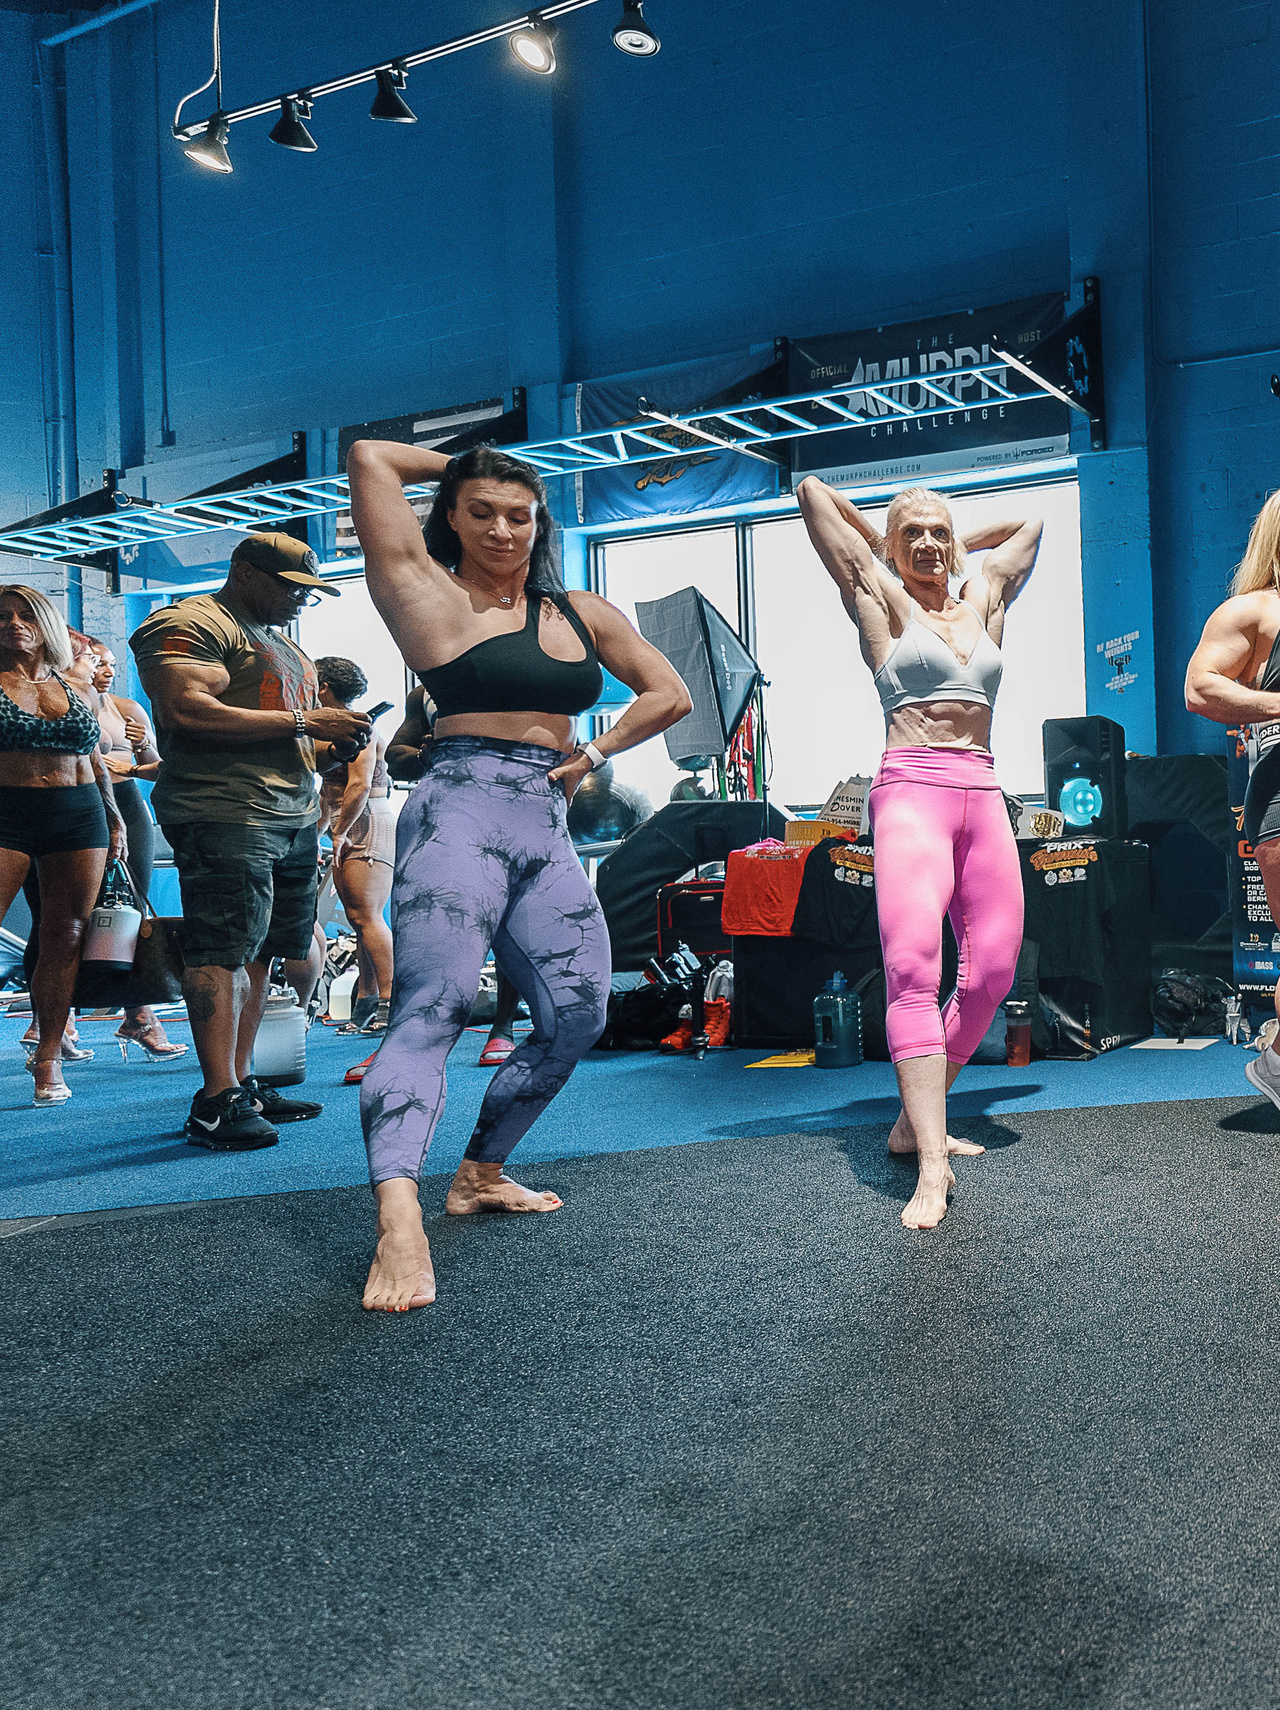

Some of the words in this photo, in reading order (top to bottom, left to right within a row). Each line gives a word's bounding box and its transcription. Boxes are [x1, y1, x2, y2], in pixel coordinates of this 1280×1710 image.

[916, 333, 954, 351] THE
[1017, 330, 1041, 344] HOST
[810, 364, 848, 381] OFFICIAL
[864, 343, 1008, 417] MURPH
[870, 406, 1006, 438] CHALLENGE
[977, 454, 1002, 463] POWERED
[1104, 642, 1132, 658] WEIGHTS
[1106, 636, 1123, 649] RACK
